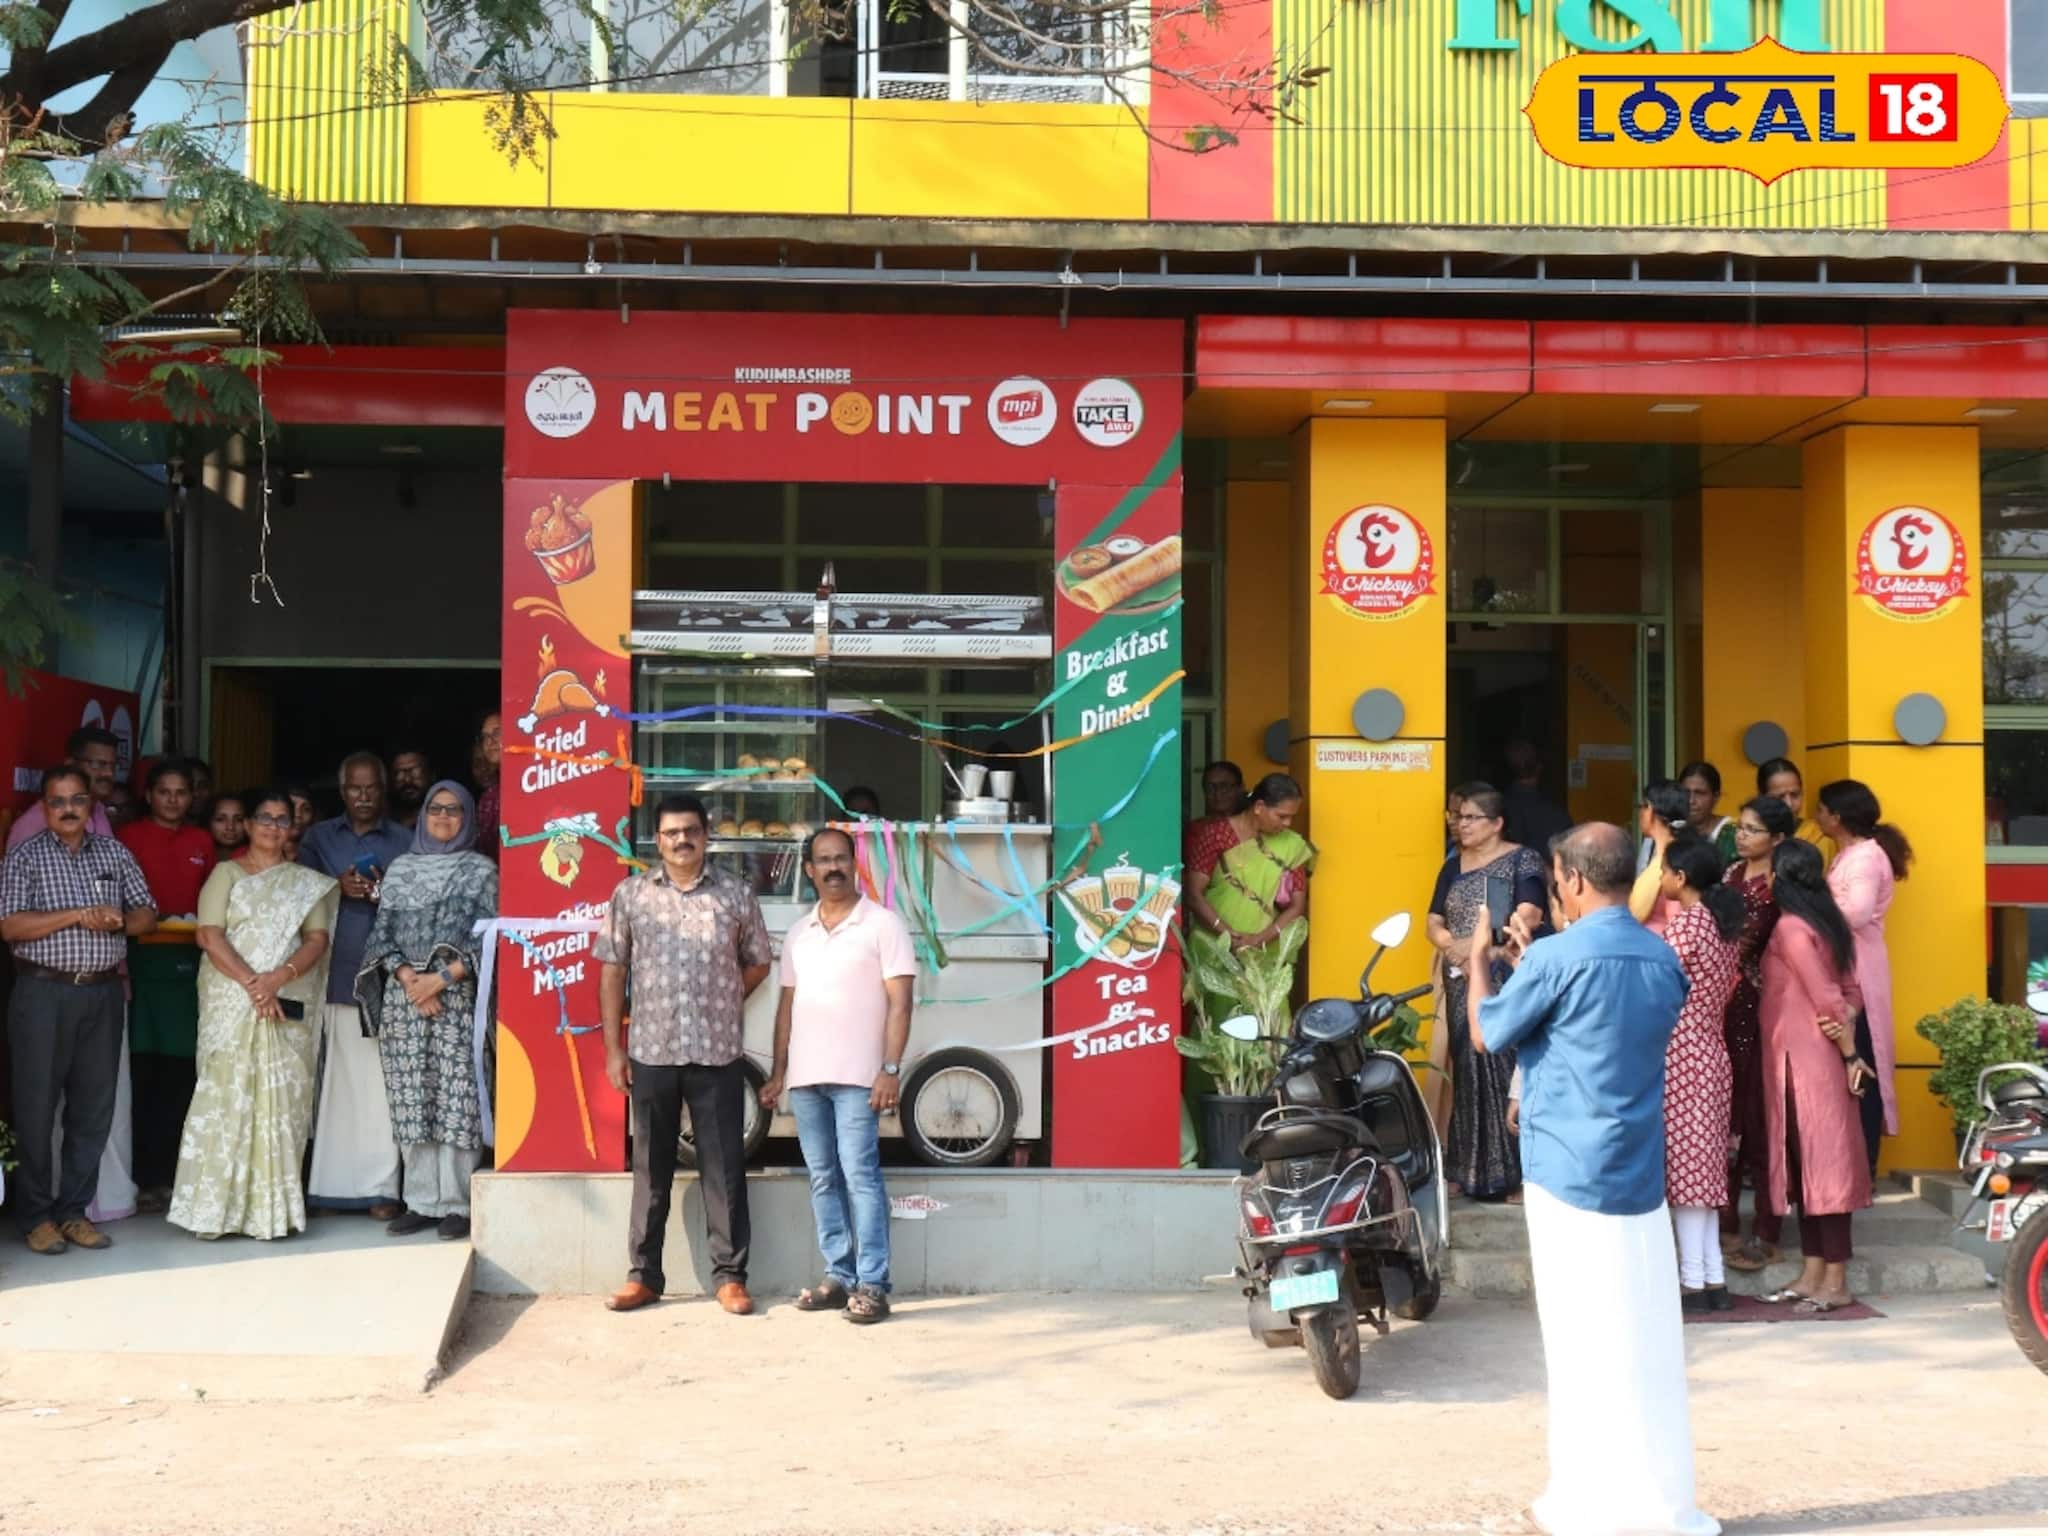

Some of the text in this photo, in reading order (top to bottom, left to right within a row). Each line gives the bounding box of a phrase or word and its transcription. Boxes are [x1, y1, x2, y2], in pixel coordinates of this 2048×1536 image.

[735, 367, 851, 384] KUDUMBASHREE
[621, 390, 972, 435] MEAT POINT
[1002, 397, 1039, 417] mpi
[1078, 406, 1126, 422] TAKE
[1342, 575, 1414, 599] Chicksy
[1875, 576, 1949, 600] Chicksy
[1066, 628, 1169, 680] Breakfast
[1106, 670, 1129, 698] &
[1081, 701, 1151, 737] Dinner
[535, 720, 587, 760] Fried
[521, 752, 609, 793] Chicken
[523, 932, 589, 969] Frozen
[533, 960, 585, 996] Meat
[1095, 974, 1148, 1000] Tea
[1072, 1022, 1170, 1060] Snacks
